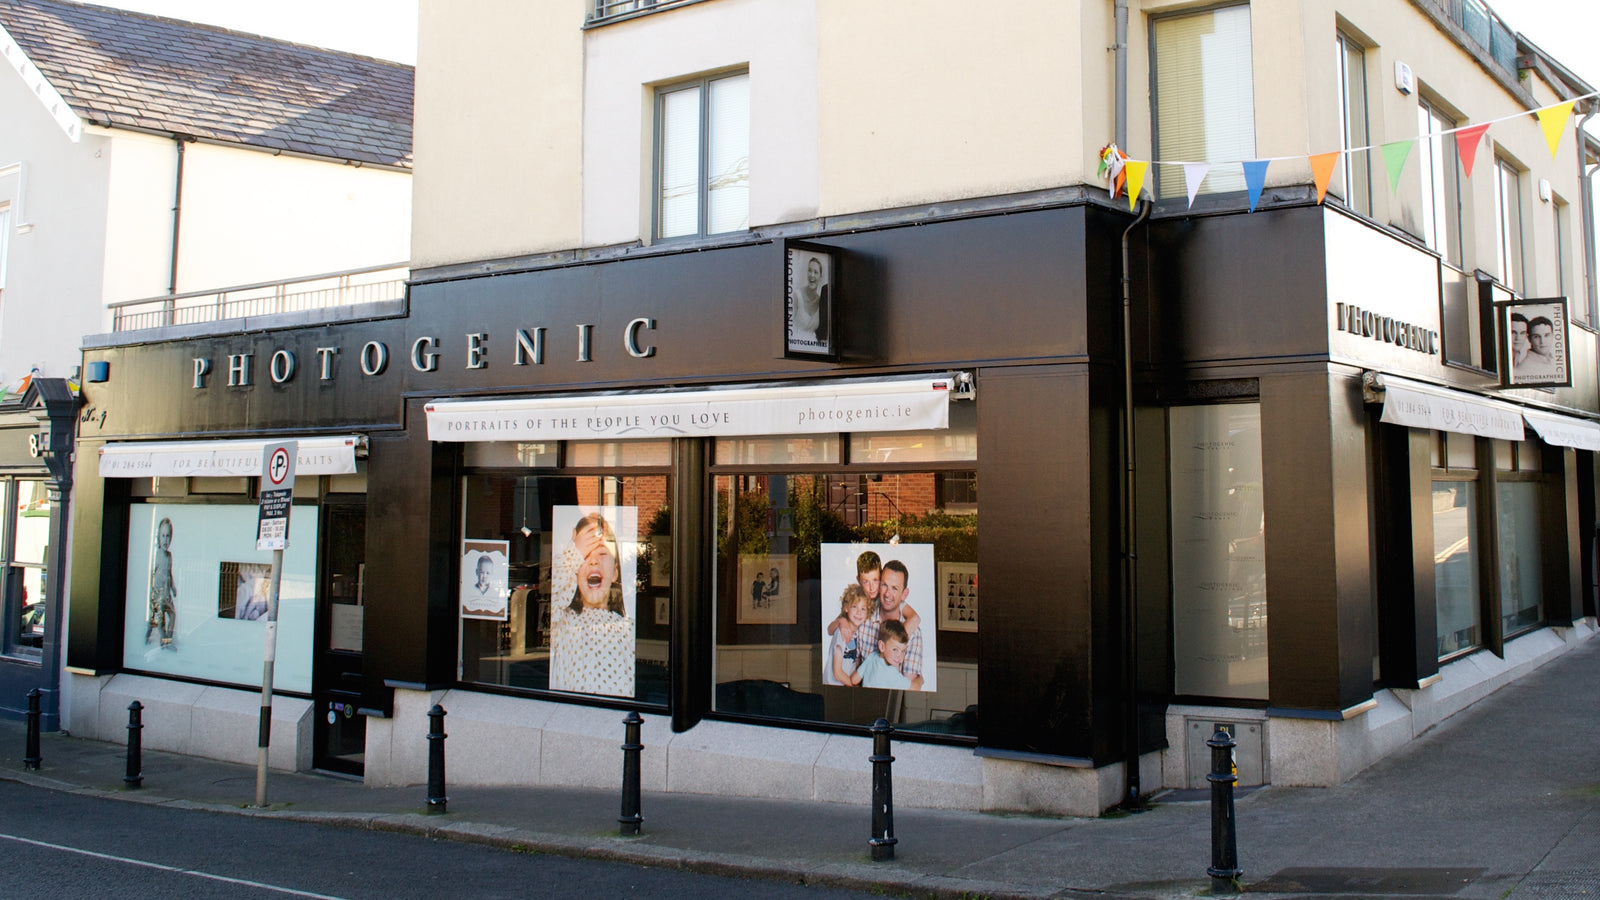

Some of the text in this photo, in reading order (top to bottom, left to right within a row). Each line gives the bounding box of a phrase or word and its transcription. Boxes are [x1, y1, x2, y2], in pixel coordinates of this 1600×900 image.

[1336, 302, 1438, 355] PHOTOGENIC
[1553, 306, 1564, 374] PHOTOGENIC
[192, 317, 657, 389] PHOTOGENIC
[448, 412, 729, 431] PORTRAITS OF THE PEOPLE YOU LOVE
[798, 405, 912, 424] photogenic.ie
[29, 433, 39, 458] 8
[173, 455, 334, 469] FOR BEAUTIFUL RAITS
